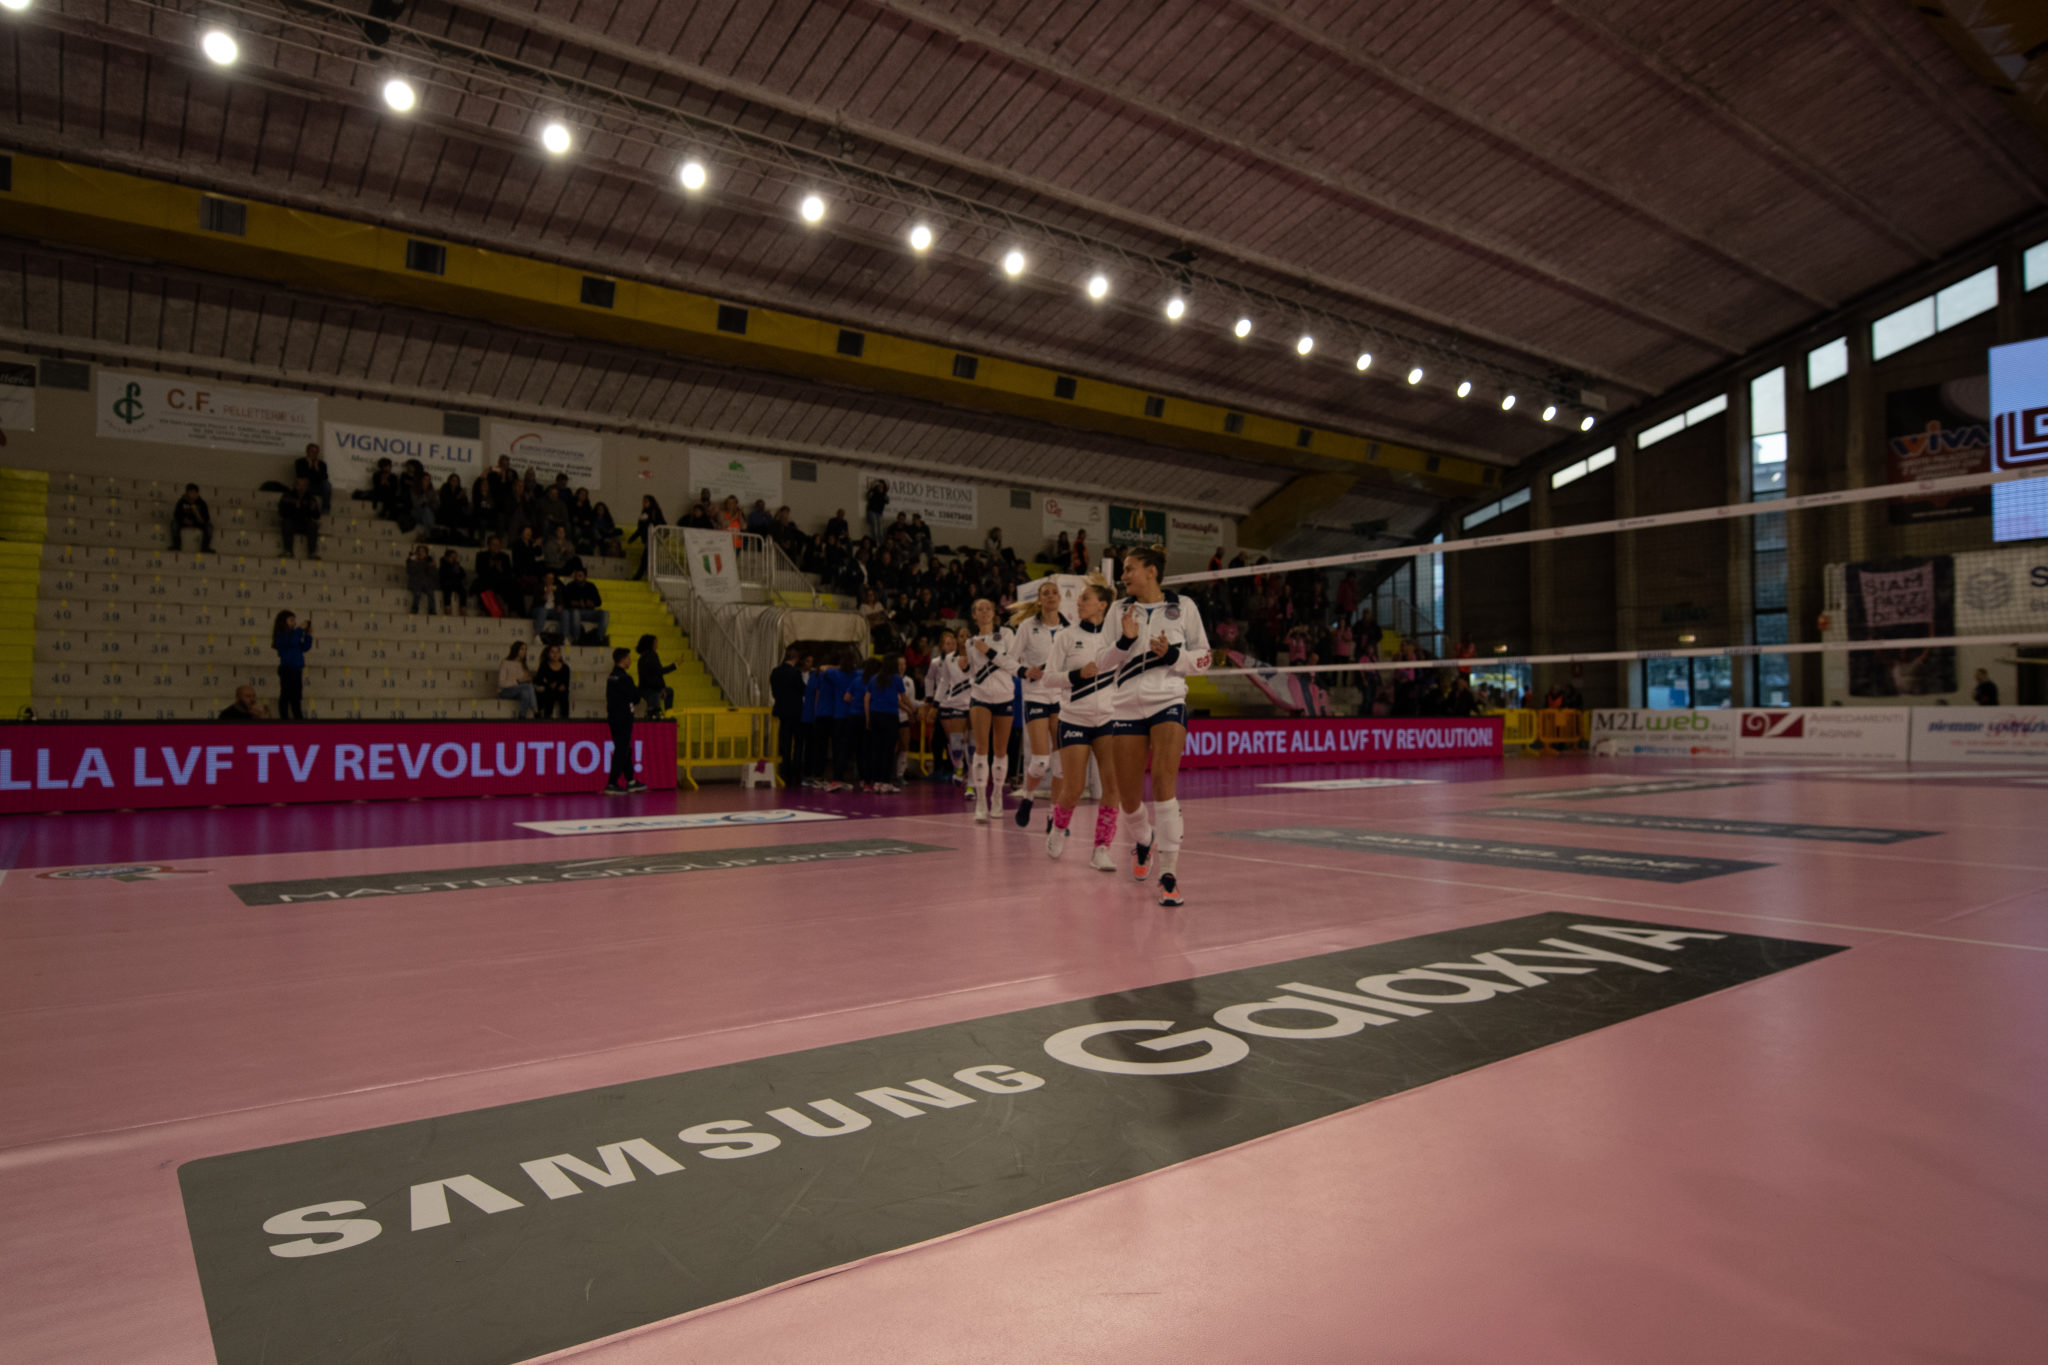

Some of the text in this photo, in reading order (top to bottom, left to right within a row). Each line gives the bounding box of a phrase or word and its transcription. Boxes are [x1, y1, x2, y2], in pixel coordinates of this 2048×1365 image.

[167, 388, 215, 414] C.F.
[335, 432, 472, 463] VIGNOLI F.LLI
[866, 477, 924, 497] EARDO
[925, 482, 973, 503] PETRONI
[1111, 527, 1164, 544] McDoald's
[1181, 727, 1493, 756] NDI PARTE ALLA LVF TV REVOLUTION!
[0, 745, 115, 790] LLA
[133, 744, 234, 786] LVF
[246, 743, 321, 784] TV
[278, 846, 914, 903] MASTER GROUP SPORT
[262, 1063, 1046, 1259] SAMSUNG
[1043, 938, 1675, 1076] Galaxy
